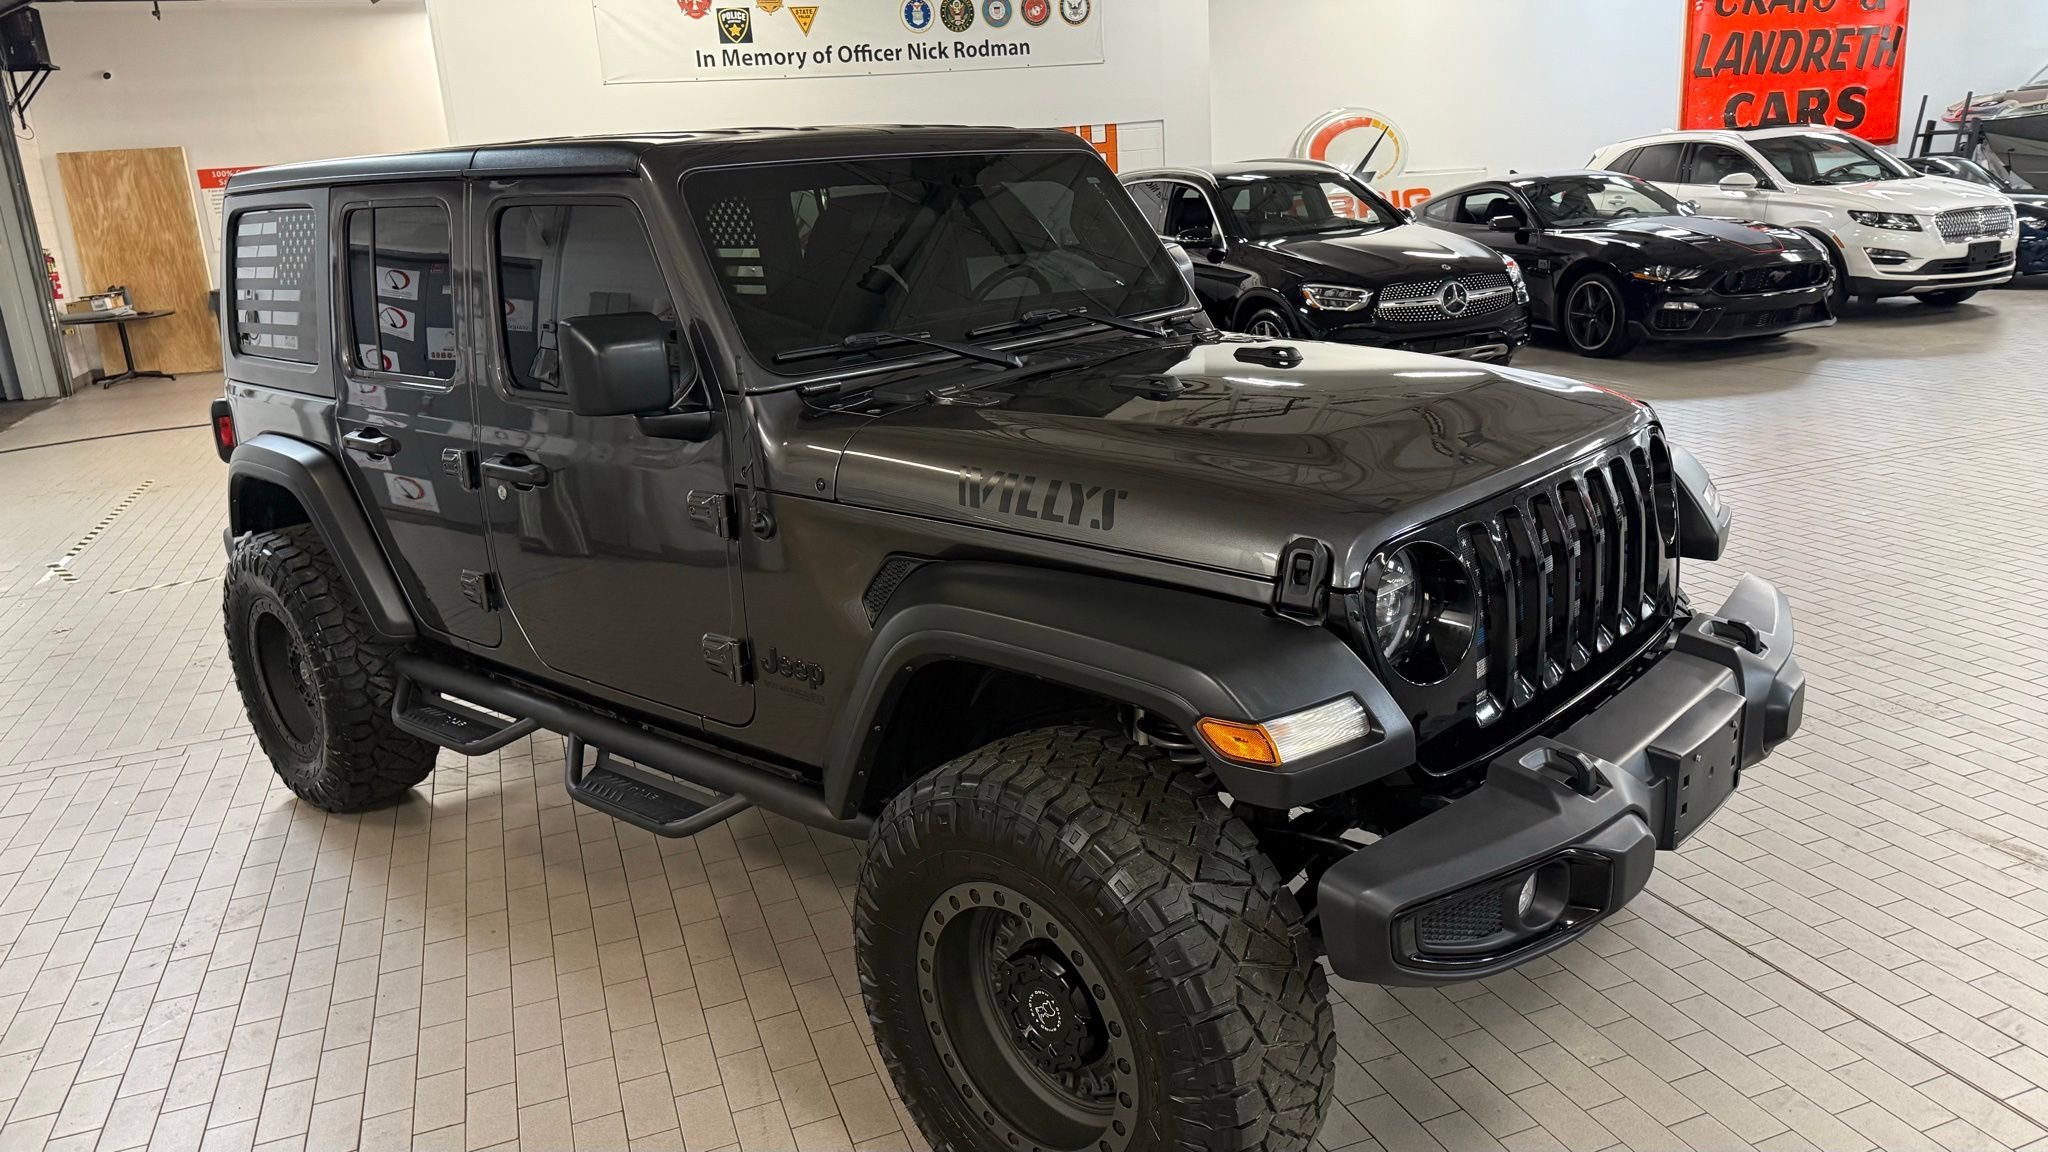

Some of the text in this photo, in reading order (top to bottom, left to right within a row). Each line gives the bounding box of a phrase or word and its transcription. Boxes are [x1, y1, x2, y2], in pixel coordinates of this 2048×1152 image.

[721, 11, 747, 22] POLICE
[696, 39, 1030, 70] In Memory of Officer Nick Rodman
[1694, 25, 1904, 78] LANDRETH
[1724, 86, 1868, 129] CARS
[958, 465, 1129, 531] WILLYS
[761, 647, 825, 690] Jeep
